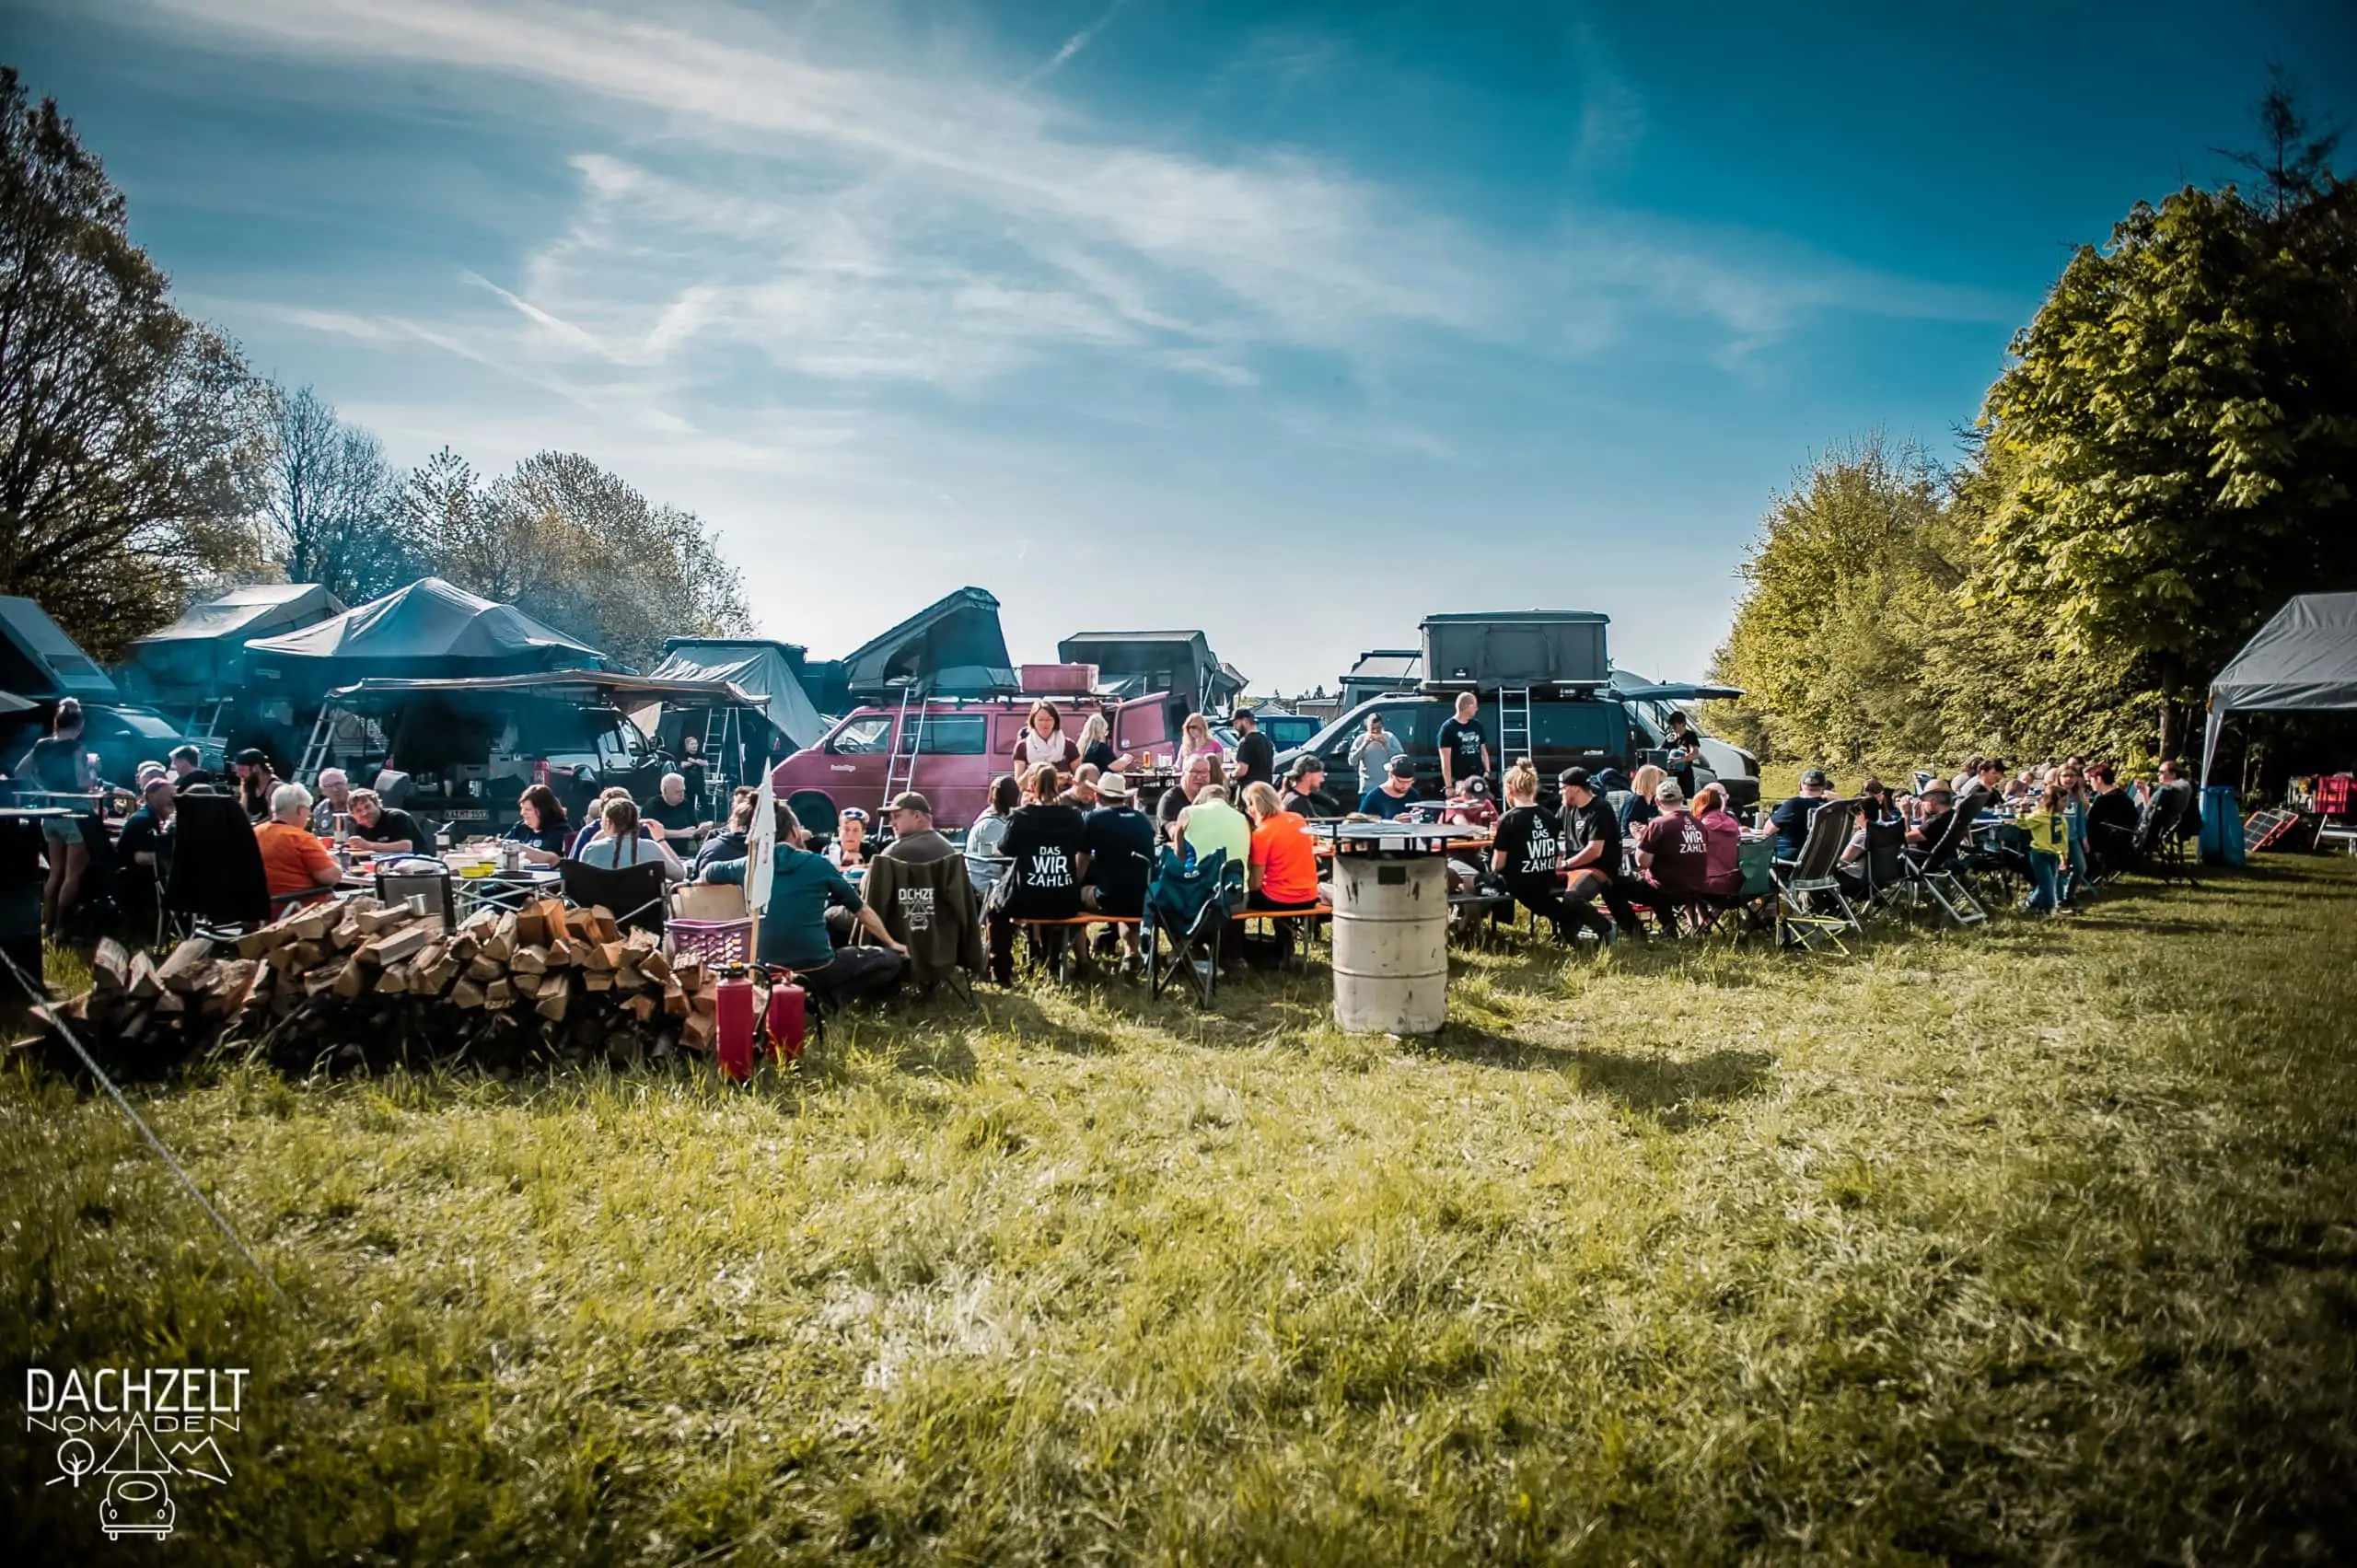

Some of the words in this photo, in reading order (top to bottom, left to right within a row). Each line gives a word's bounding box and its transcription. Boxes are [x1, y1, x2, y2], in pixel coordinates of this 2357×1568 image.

[1532, 829, 1550, 839] DAS
[1681, 830, 1703, 843] WIR
[1039, 846, 1062, 855] DAS
[1527, 838, 1555, 859] WIR
[1032, 855, 1068, 874] WIR
[1521, 856, 1555, 873] ZAHL
